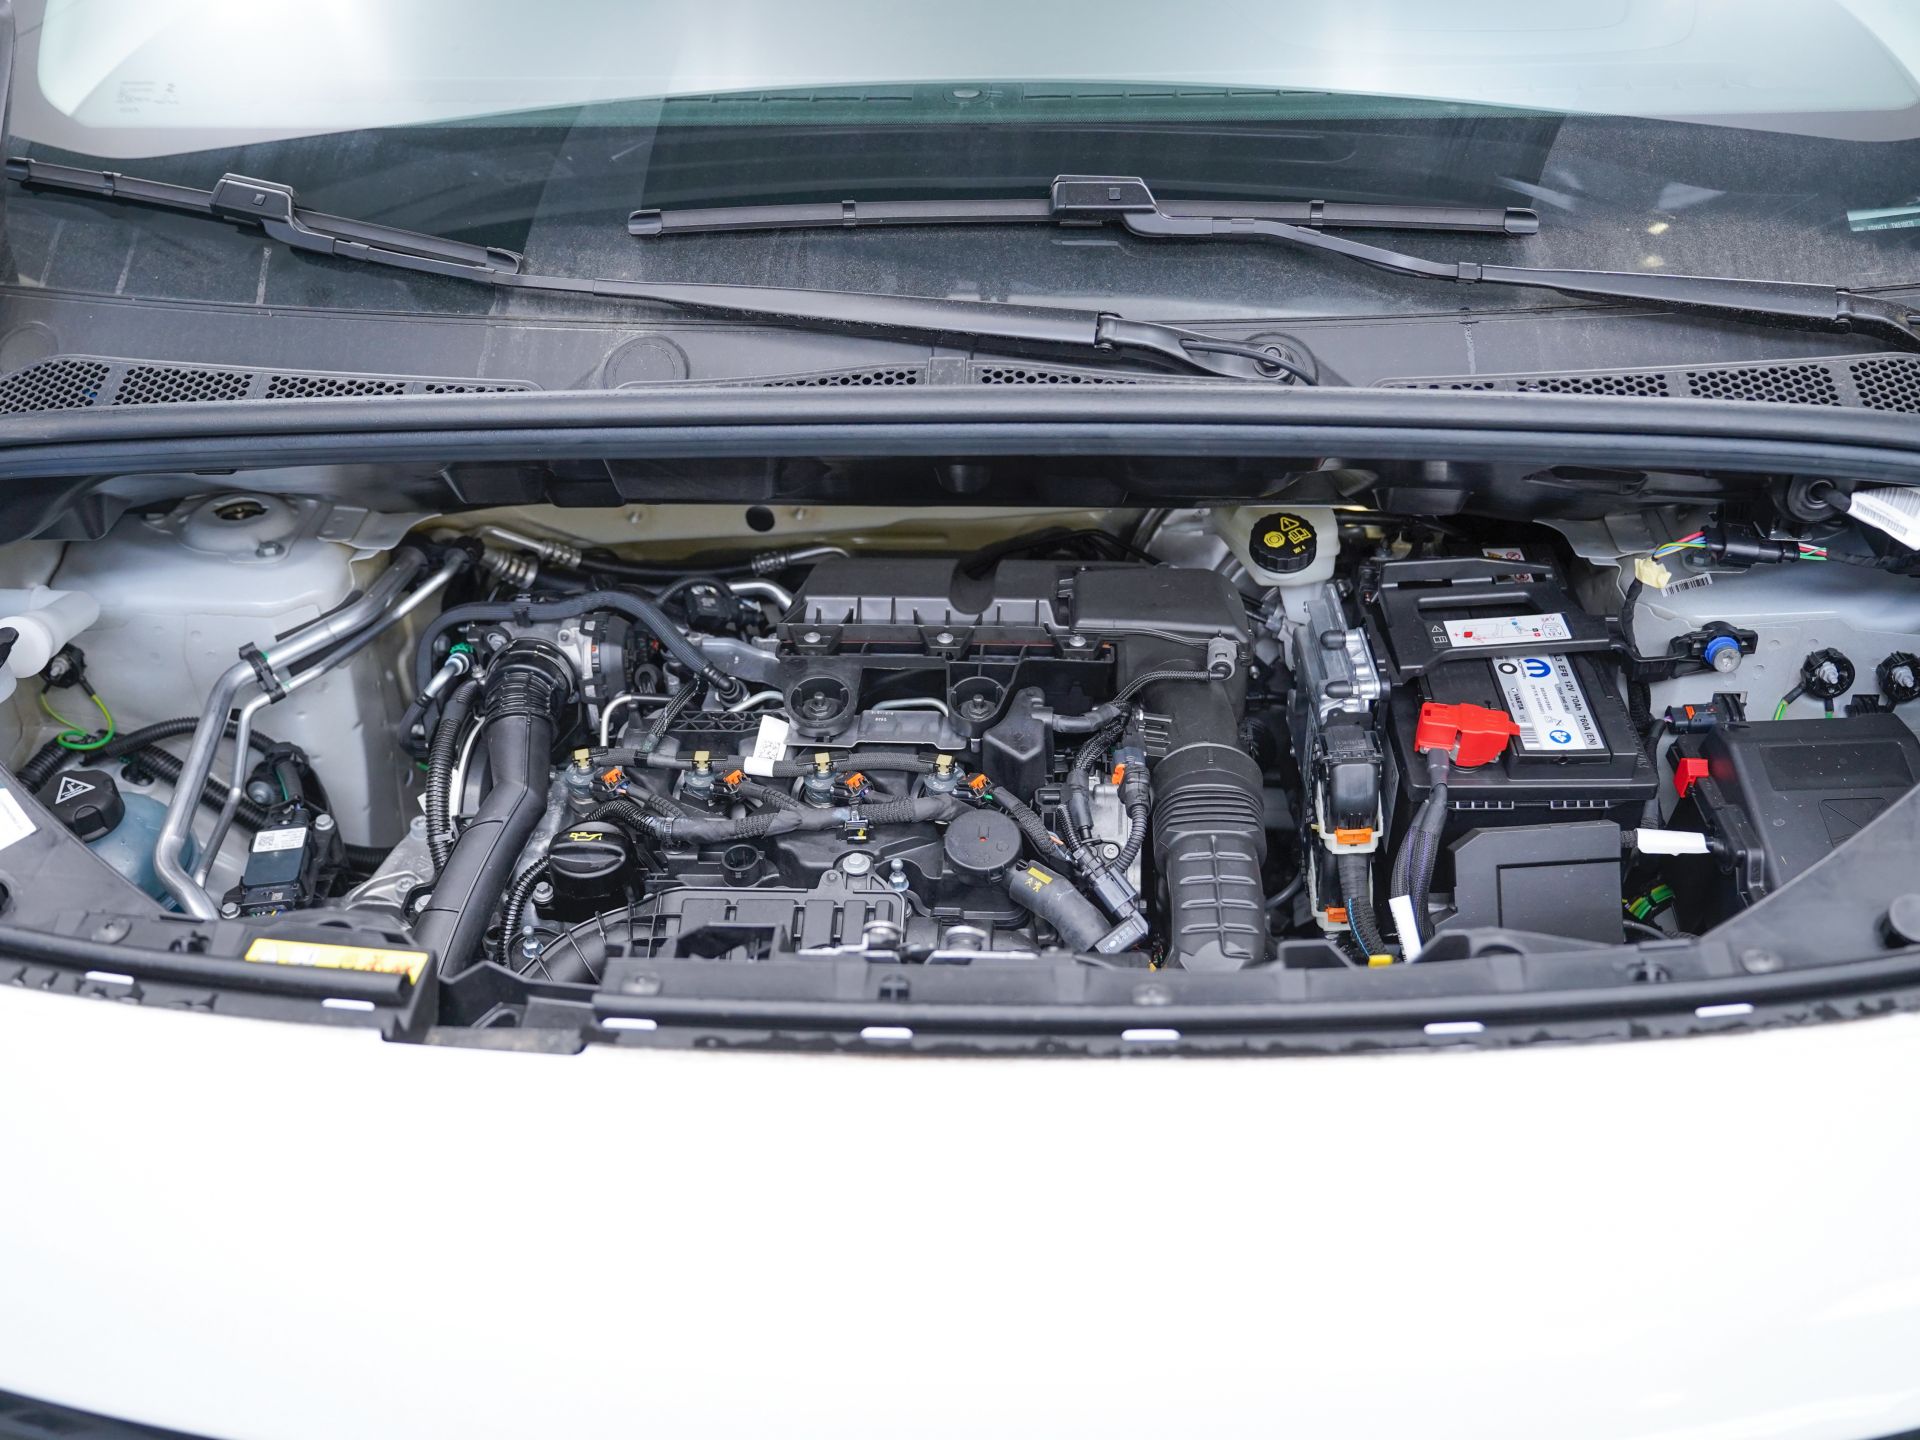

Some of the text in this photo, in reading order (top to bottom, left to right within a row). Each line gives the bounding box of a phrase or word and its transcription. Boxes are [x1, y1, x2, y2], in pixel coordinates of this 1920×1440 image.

[1558, 665, 1569, 676] EFB
[1564, 681, 1575, 691] 12V
[1570, 695, 1582, 711] 70Ah
[1578, 714, 1591, 730] 760A
[1584, 732, 1597, 745] (EN)
